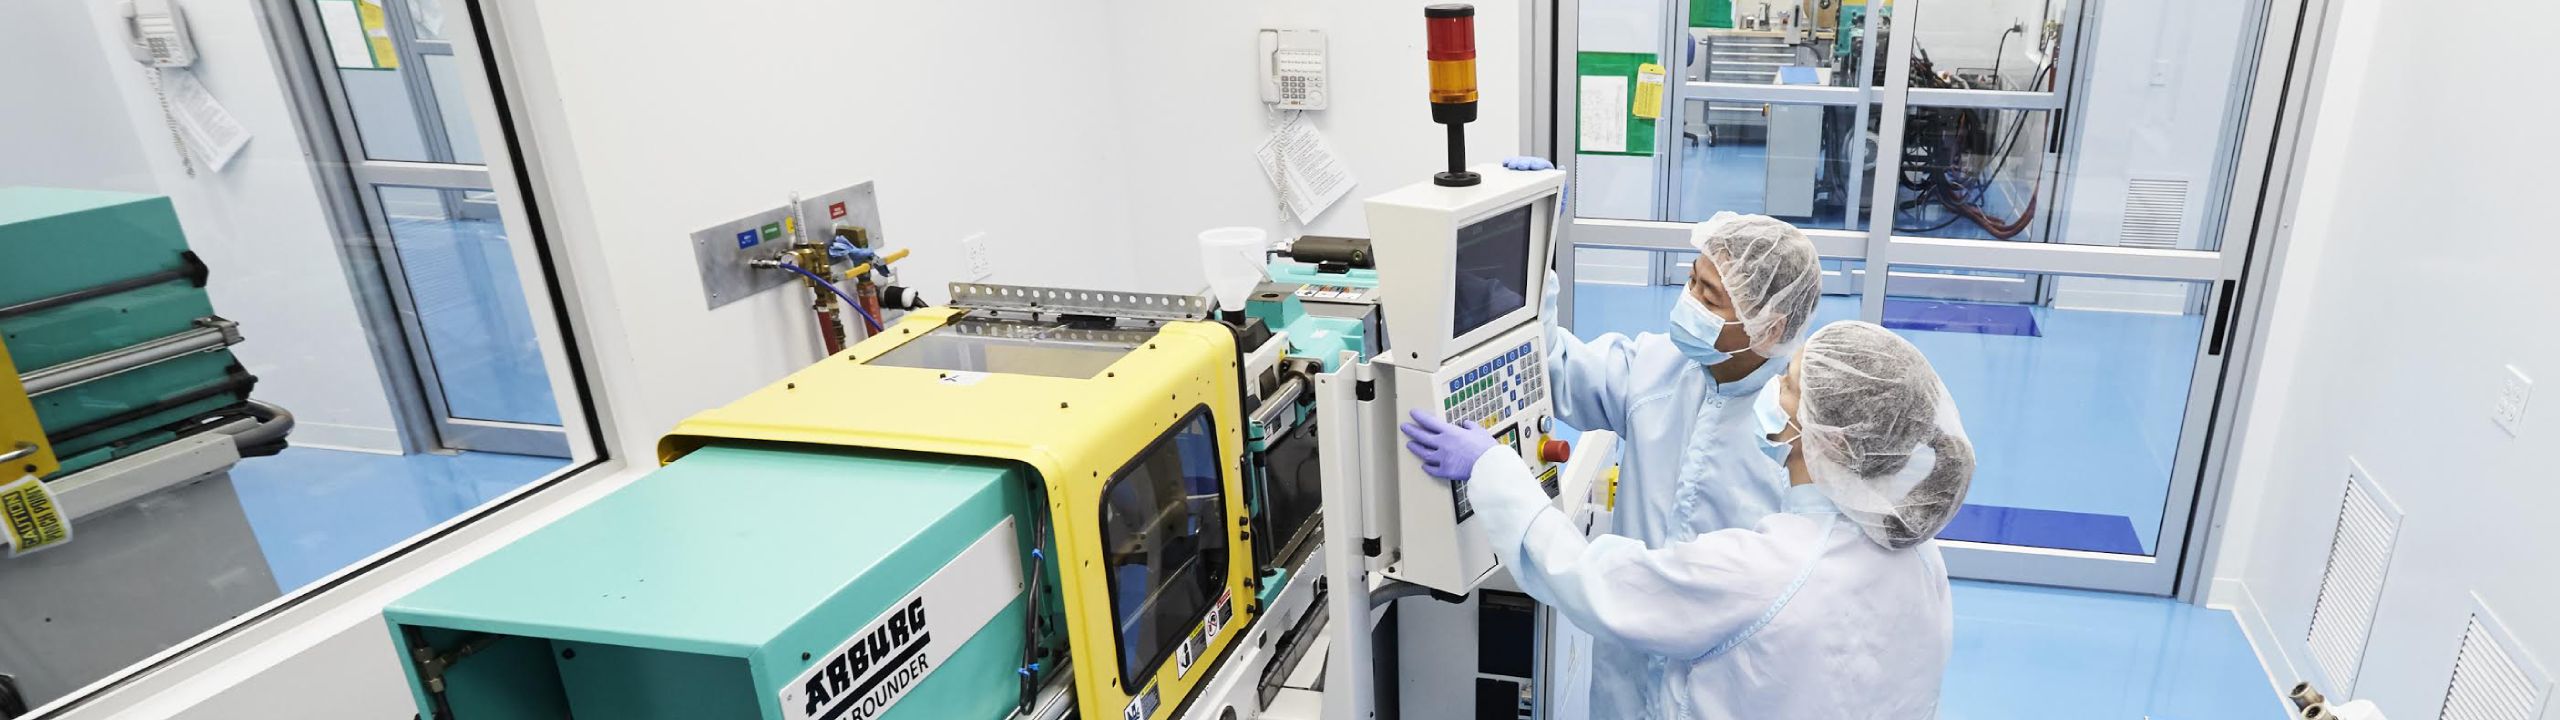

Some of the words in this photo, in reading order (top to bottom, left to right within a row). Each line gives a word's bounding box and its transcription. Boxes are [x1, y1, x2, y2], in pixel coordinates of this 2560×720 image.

[5, 491, 40, 549] CAUTION
[25, 485, 50, 514] POINT
[36, 512, 62, 542] PINCH
[805, 596, 926, 718] ARBURG
[842, 653, 929, 720] ROUNDER
